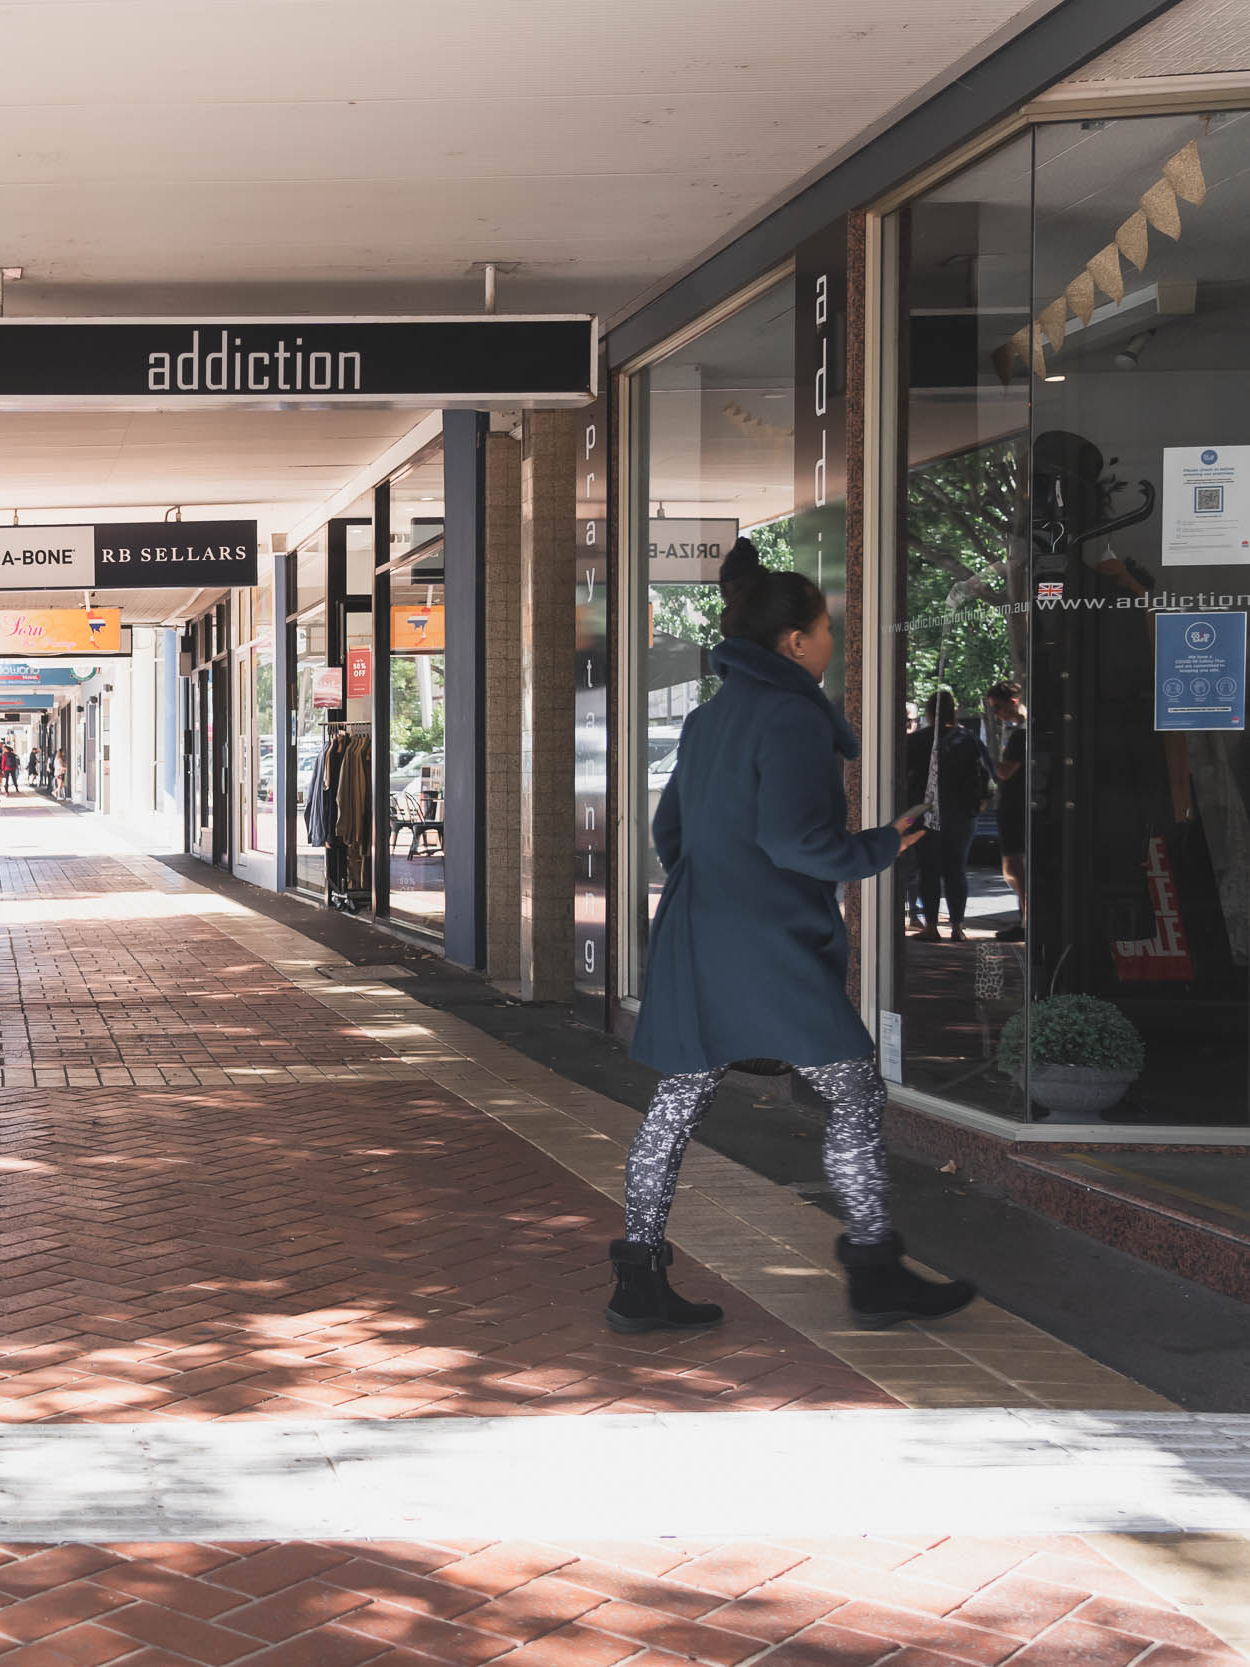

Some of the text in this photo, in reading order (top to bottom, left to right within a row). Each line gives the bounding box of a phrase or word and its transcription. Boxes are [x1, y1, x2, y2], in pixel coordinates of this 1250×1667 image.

[148, 330, 361, 391] addiction
[102, 546, 247, 563] RB SELLARS
[814, 274, 827, 688] addi
[584, 424, 596, 974] pray tanning
